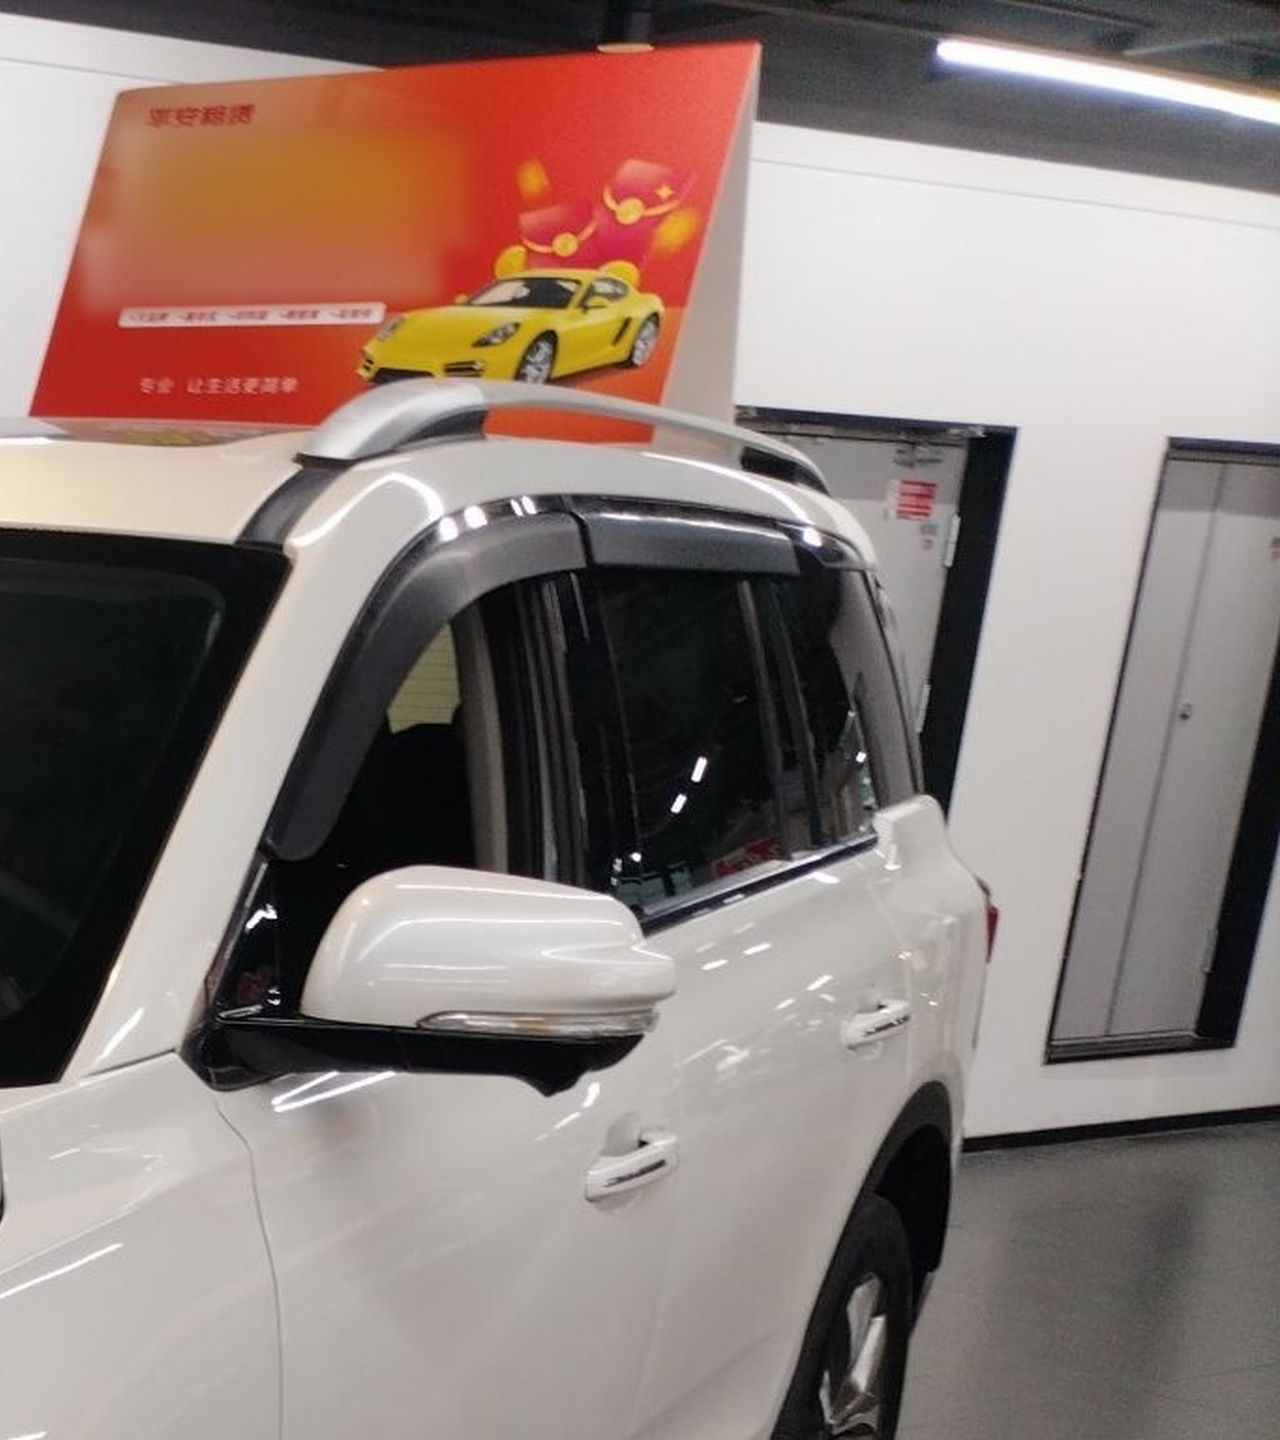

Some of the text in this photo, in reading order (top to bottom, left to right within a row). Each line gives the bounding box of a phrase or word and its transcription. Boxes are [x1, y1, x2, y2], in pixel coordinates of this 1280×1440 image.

[186, 376, 299, 395] 让生活更简单
